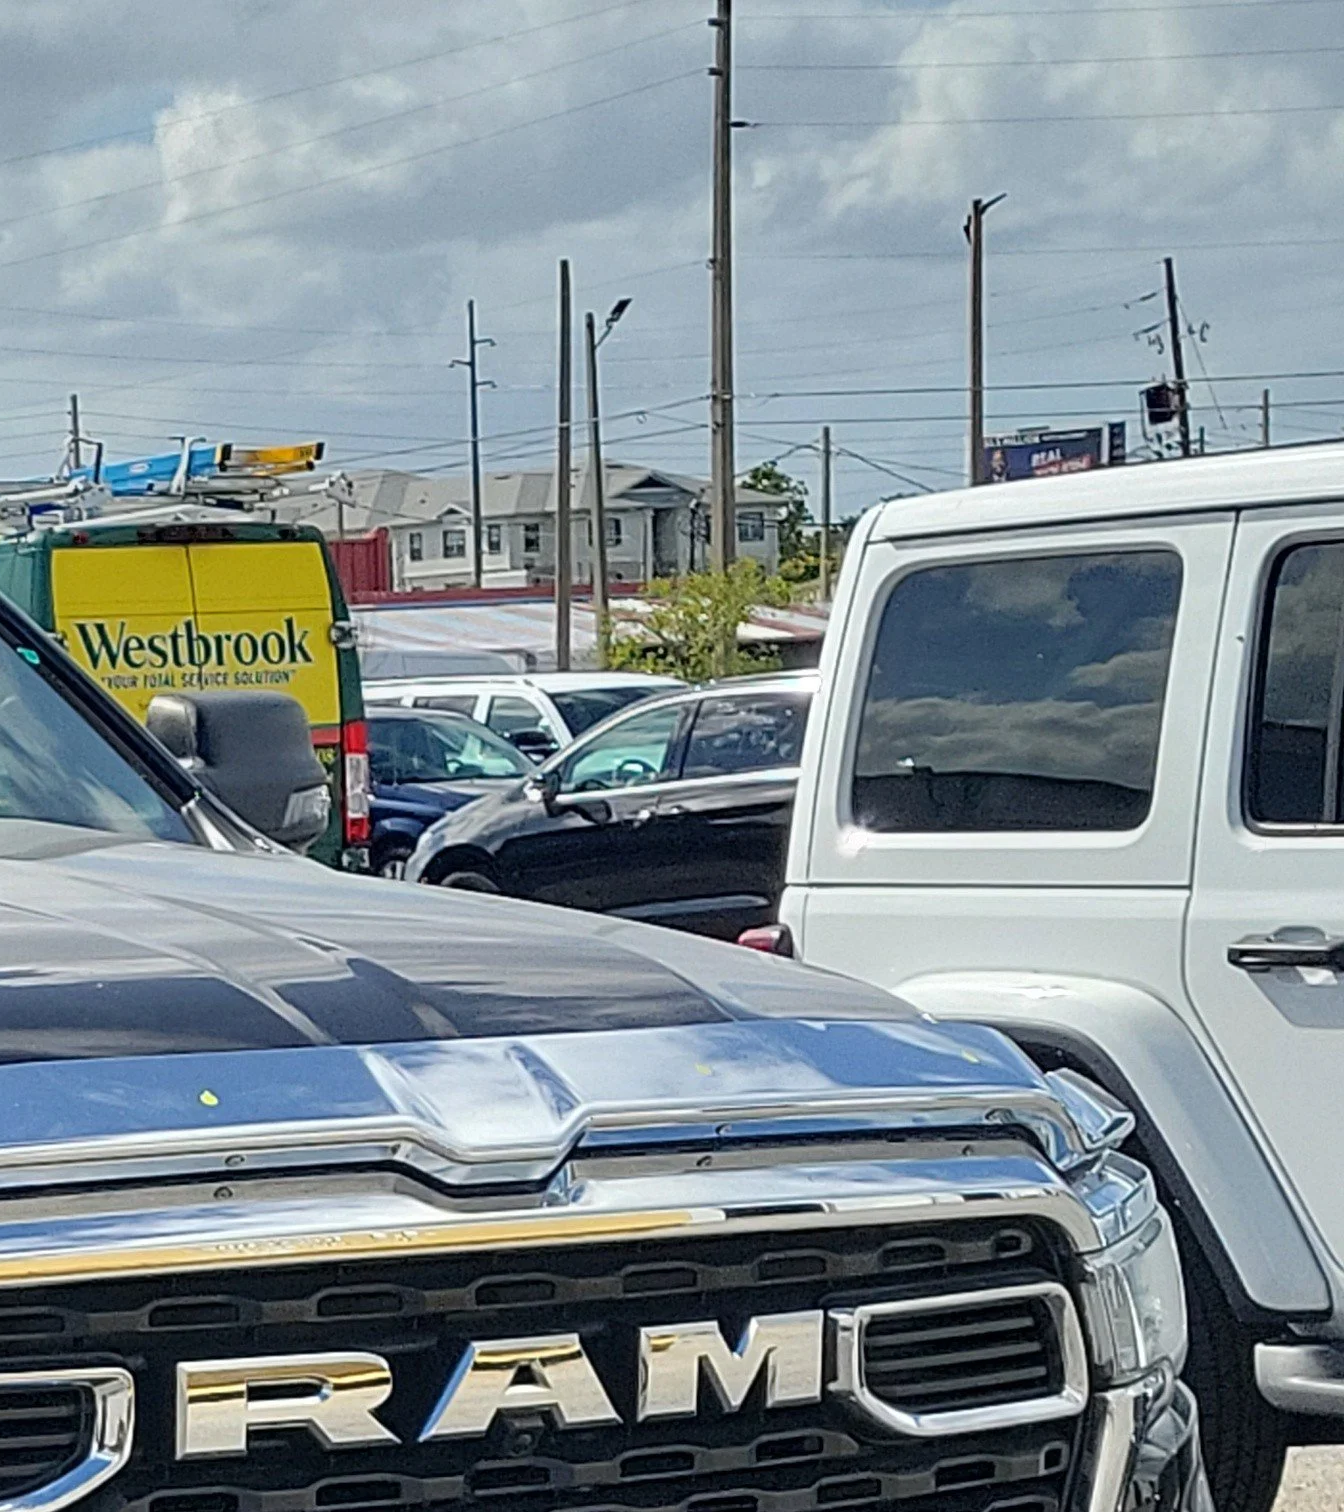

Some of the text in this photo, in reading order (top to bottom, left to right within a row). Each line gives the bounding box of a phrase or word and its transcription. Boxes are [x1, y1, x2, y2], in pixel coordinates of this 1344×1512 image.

[75, 616, 313, 670] Westbrook
[144, 673, 176, 689] TOTAL
[181, 671, 228, 688] SERVICE
[175, 1308, 824, 1460] RAM
